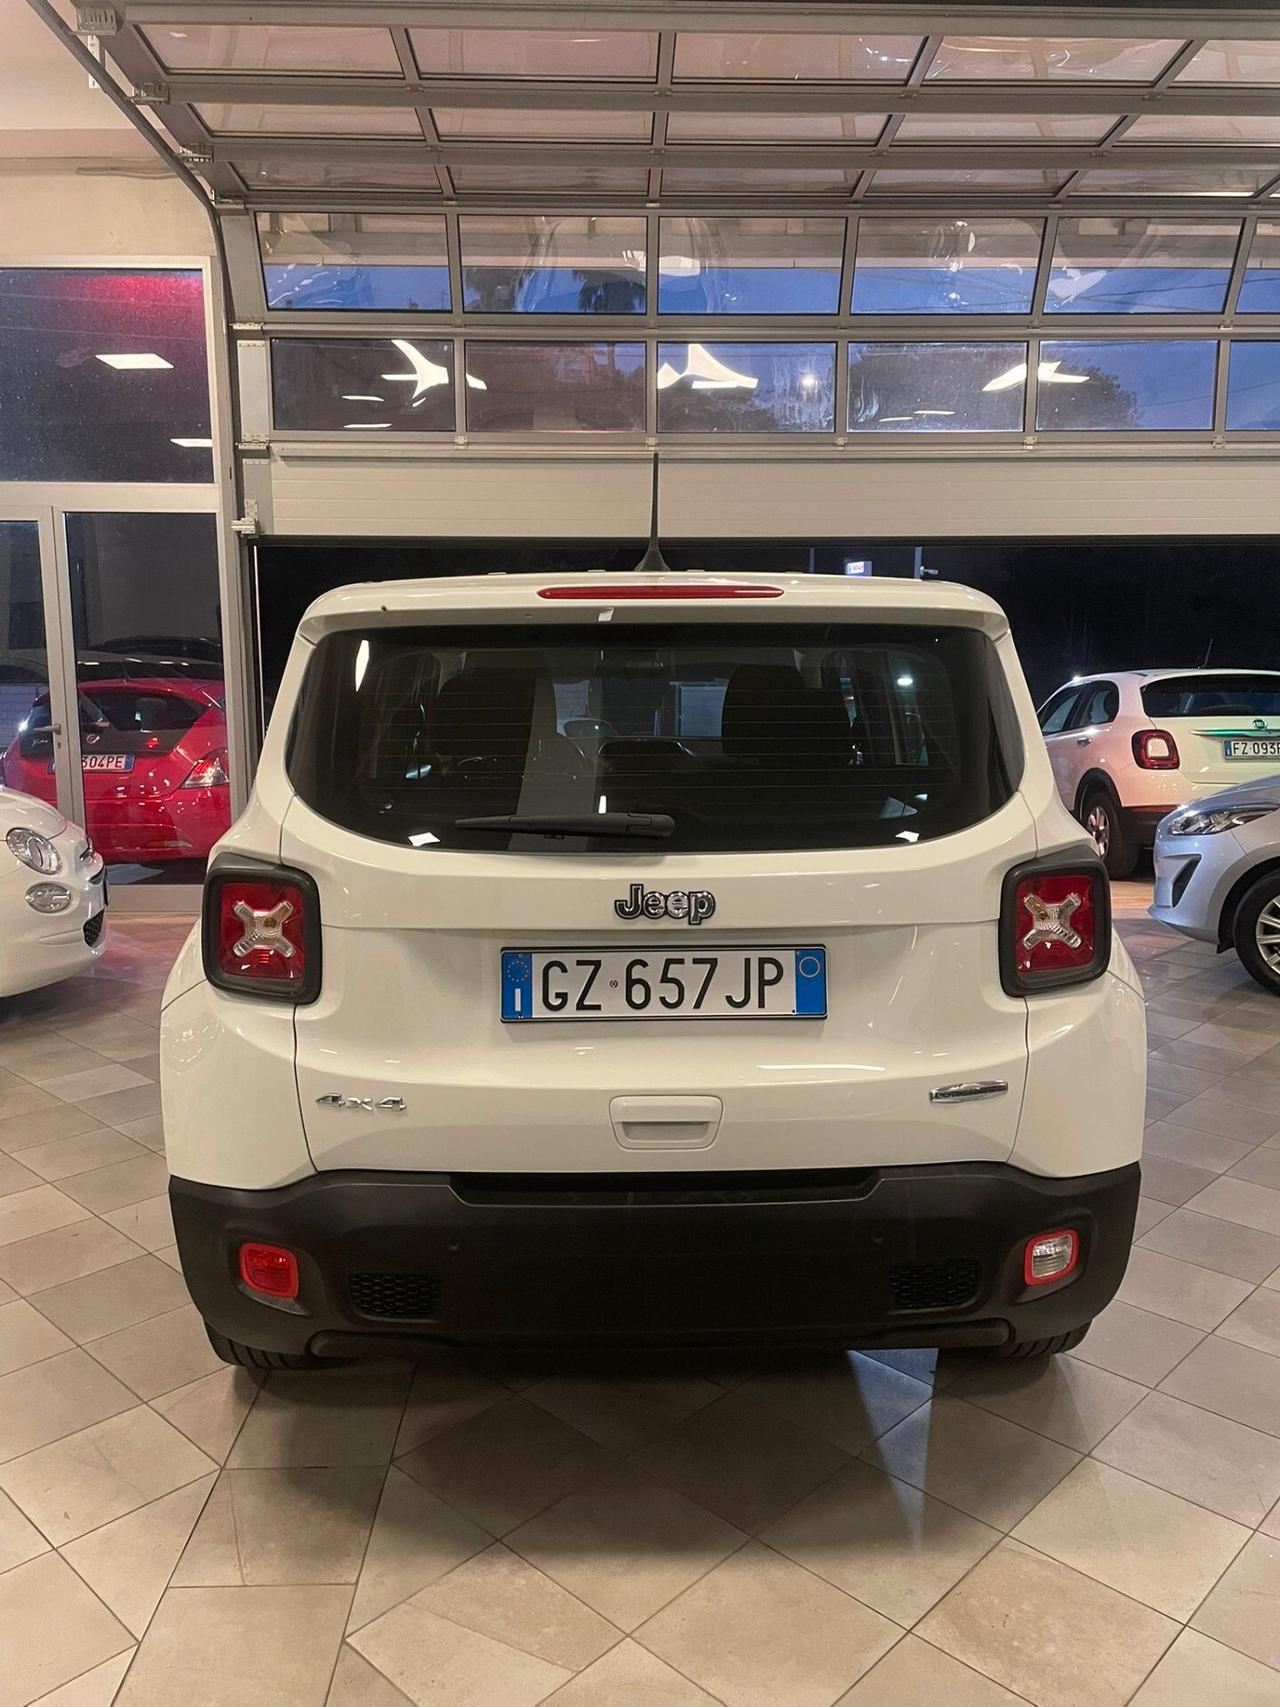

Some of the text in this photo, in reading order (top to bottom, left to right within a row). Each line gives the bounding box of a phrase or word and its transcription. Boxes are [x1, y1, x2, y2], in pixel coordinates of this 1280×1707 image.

[1233, 742, 1248, 755] FZ
[615, 883, 716, 925] Jeep
[542, 957, 784, 1012] GZ 657JP
